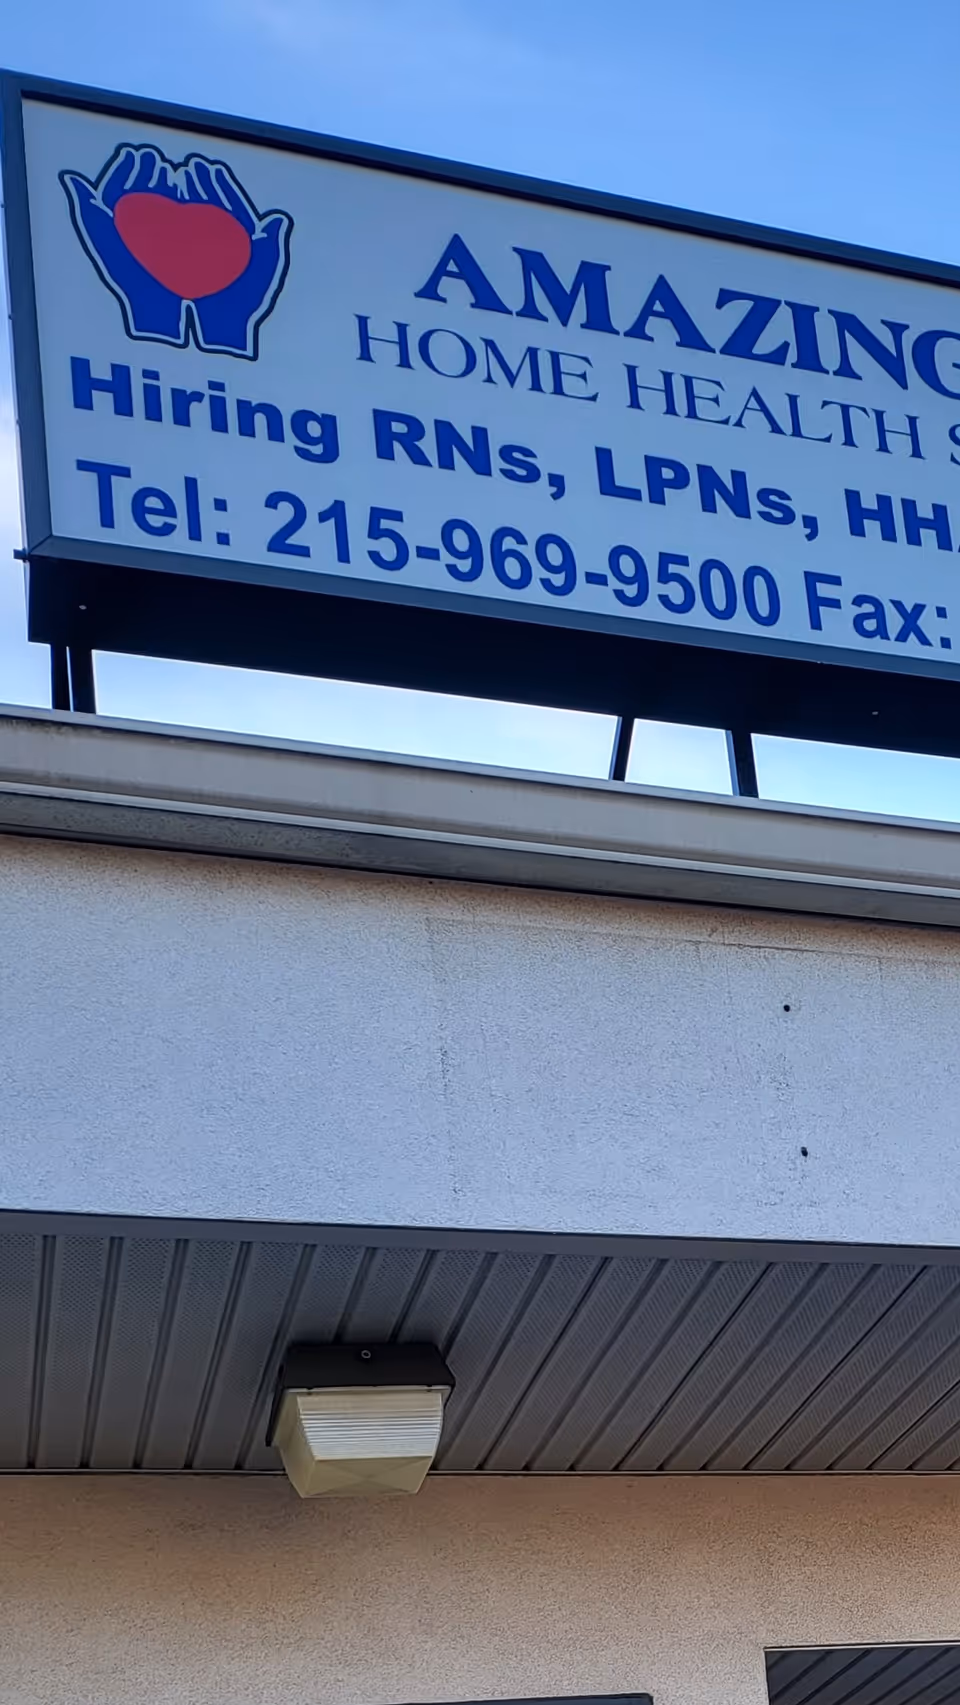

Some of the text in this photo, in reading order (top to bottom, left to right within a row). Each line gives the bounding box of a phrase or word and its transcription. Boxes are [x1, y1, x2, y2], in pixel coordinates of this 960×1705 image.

[70, 356, 340, 464] Hiring
[372, 408, 566, 500] RNs,
[594, 446, 819, 541] LPNs,
[354, 314, 599, 402] HOME
[625, 363, 925, 461] HEALTH
[76, 460, 232, 546] Tel:
[264, 490, 781, 627] 215-969-9500
[804, 570, 952, 651] Fax:
